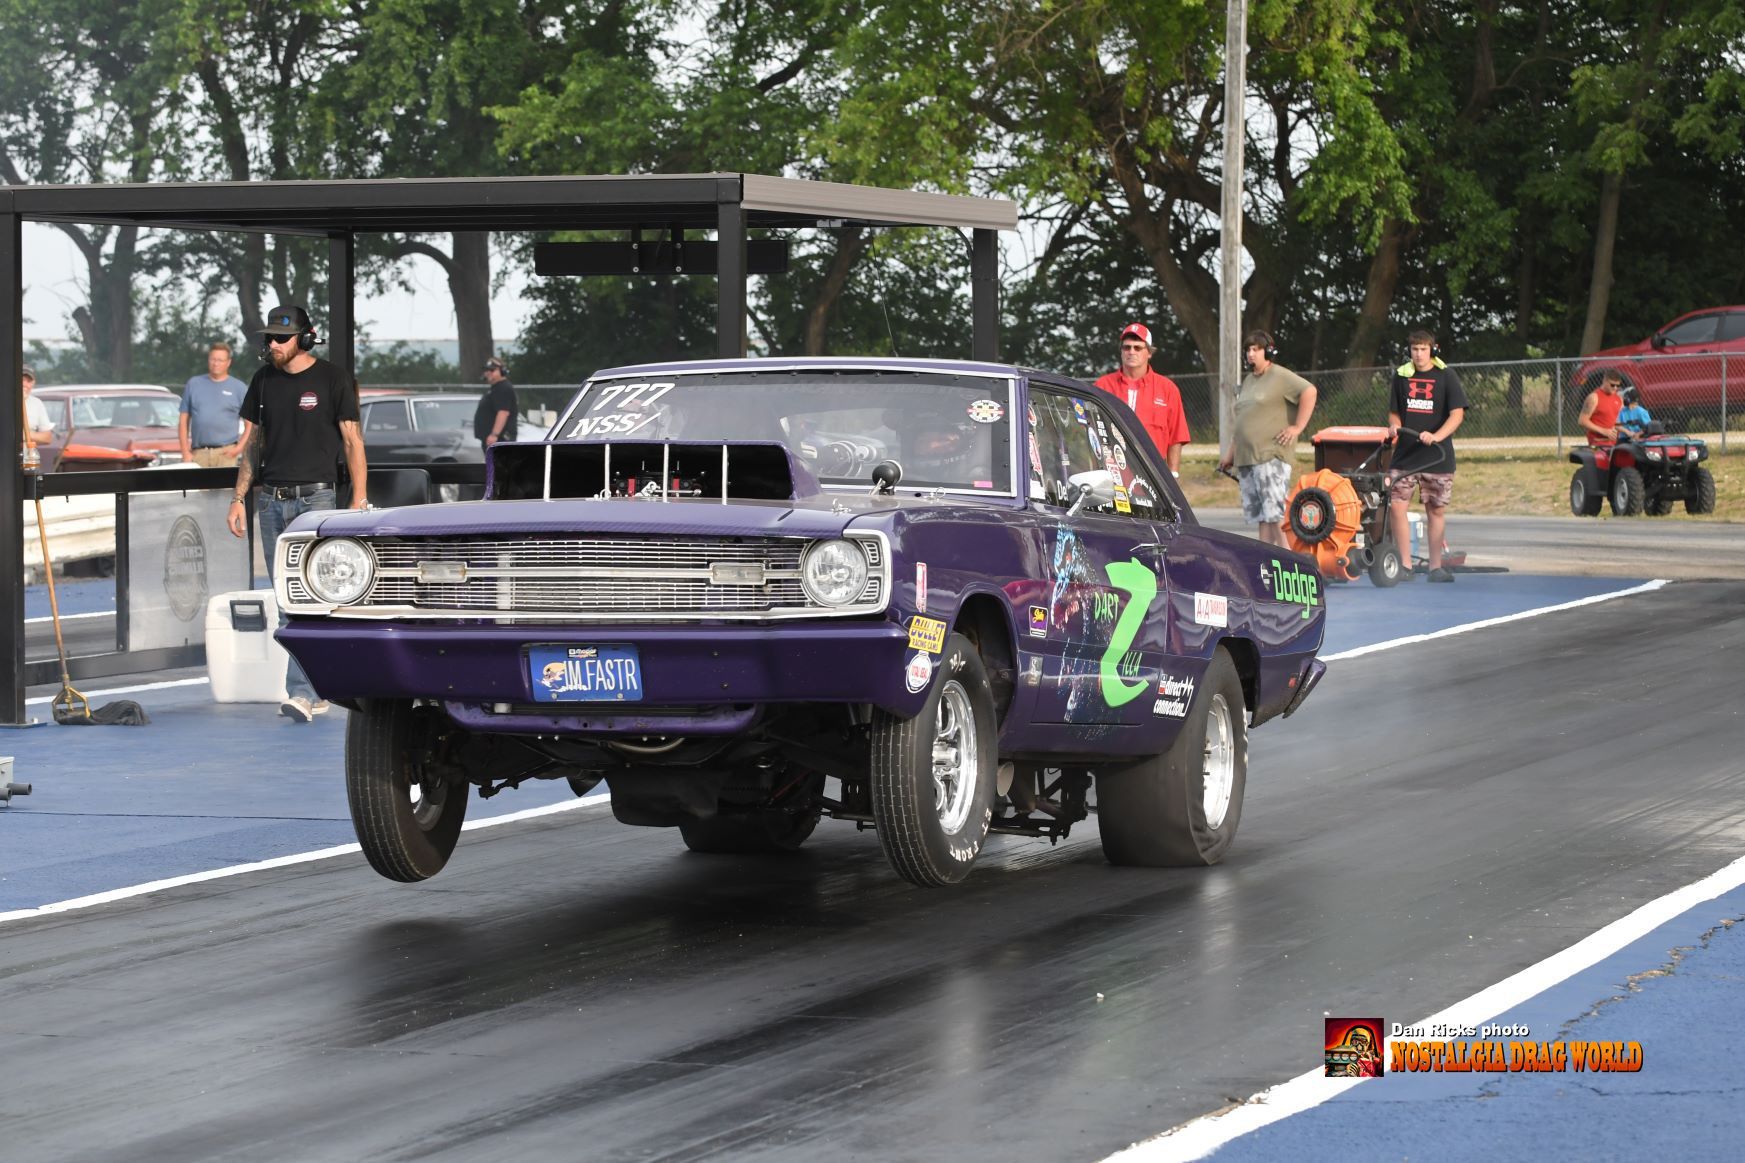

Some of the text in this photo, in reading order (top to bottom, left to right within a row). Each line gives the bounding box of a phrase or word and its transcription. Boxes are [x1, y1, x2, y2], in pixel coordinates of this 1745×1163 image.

[594, 382, 676, 411] 777
[1271, 559, 1319, 620] Dodge
[1094, 591, 1119, 621] DART
[1121, 652, 1143, 677] ILLA
[1153, 697, 1185, 717] connection
